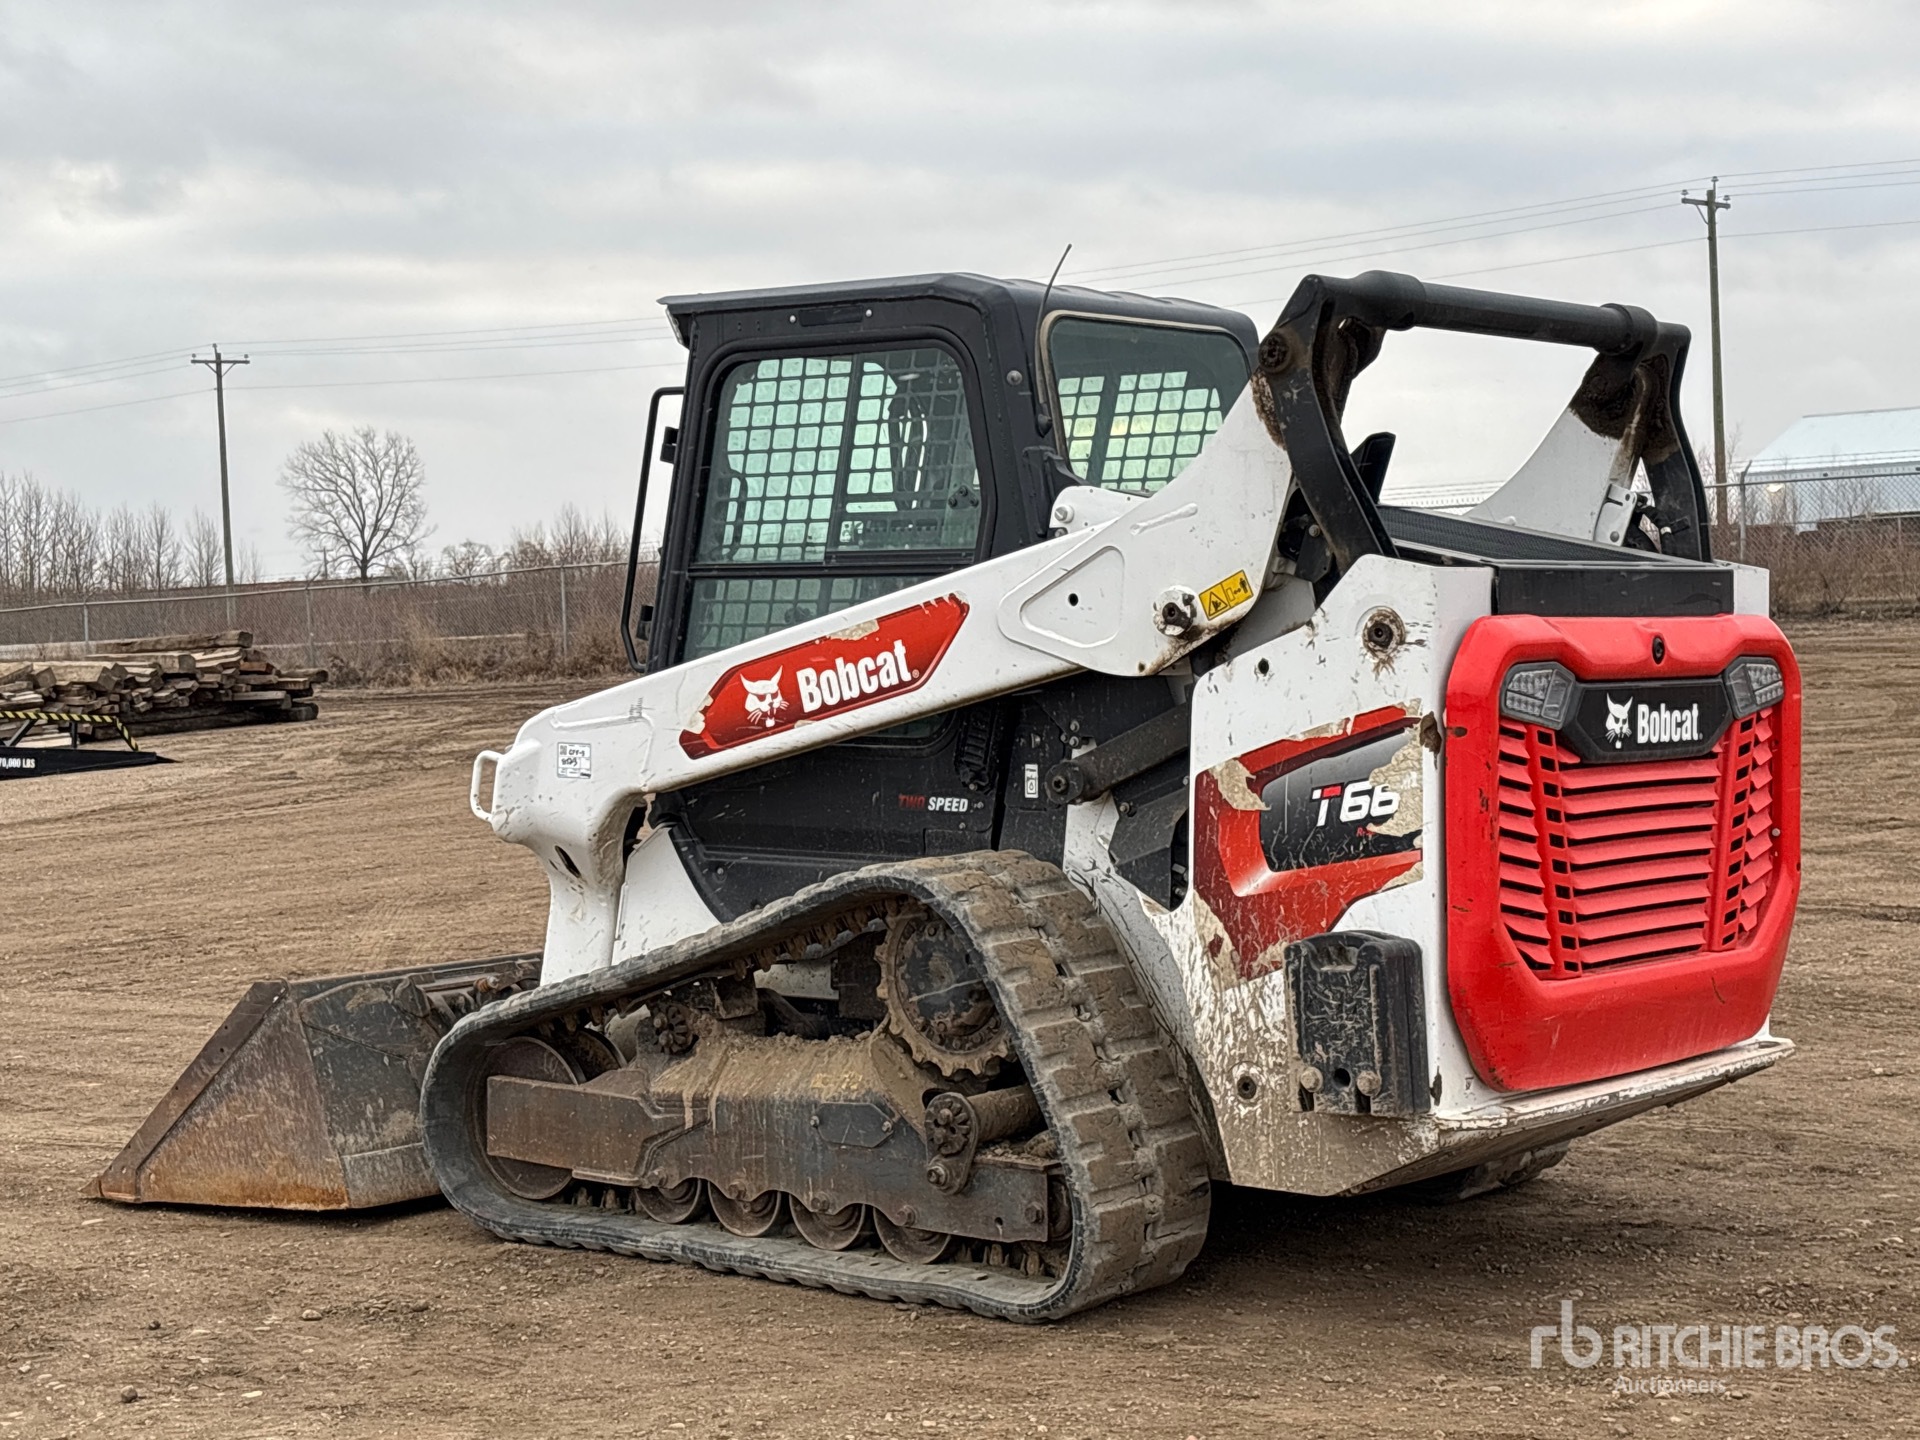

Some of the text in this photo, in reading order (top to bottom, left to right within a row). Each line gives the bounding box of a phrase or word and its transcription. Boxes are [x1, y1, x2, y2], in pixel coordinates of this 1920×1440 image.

[796, 639, 912, 713] Bobcat
[1637, 703, 1699, 744] Bobcat
[22, 759, 35, 769] LBS
[898, 794, 969, 812] TWO SPEED
[1311, 780, 1400, 827] T66
